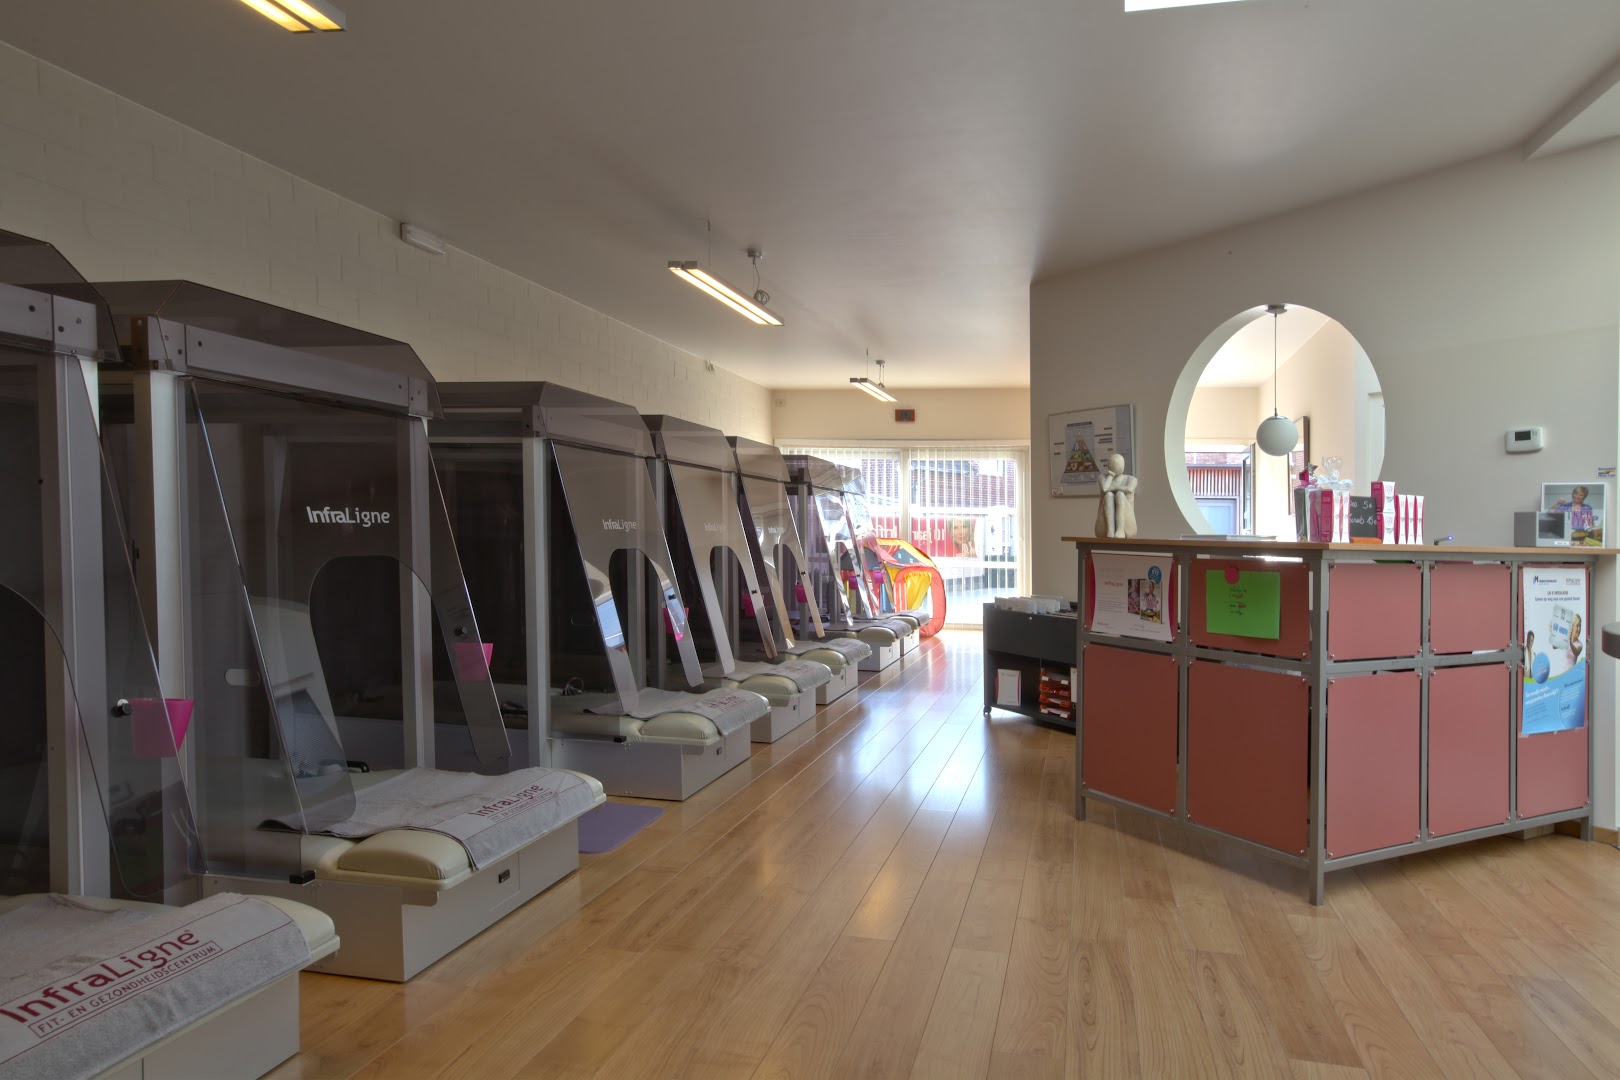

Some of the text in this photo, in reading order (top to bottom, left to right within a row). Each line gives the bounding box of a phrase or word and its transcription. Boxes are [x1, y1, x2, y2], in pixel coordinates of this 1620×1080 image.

[306, 506, 391, 528] InfraLigne
[602, 518, 638, 532] InfraLigne
[467, 784, 544, 817] InfraLigne
[0, 929, 200, 1024] InfraLigne
[68, 1003, 87, 1019] EN
[89, 945, 218, 1009] GEZONDHEIDSCENTRUM
